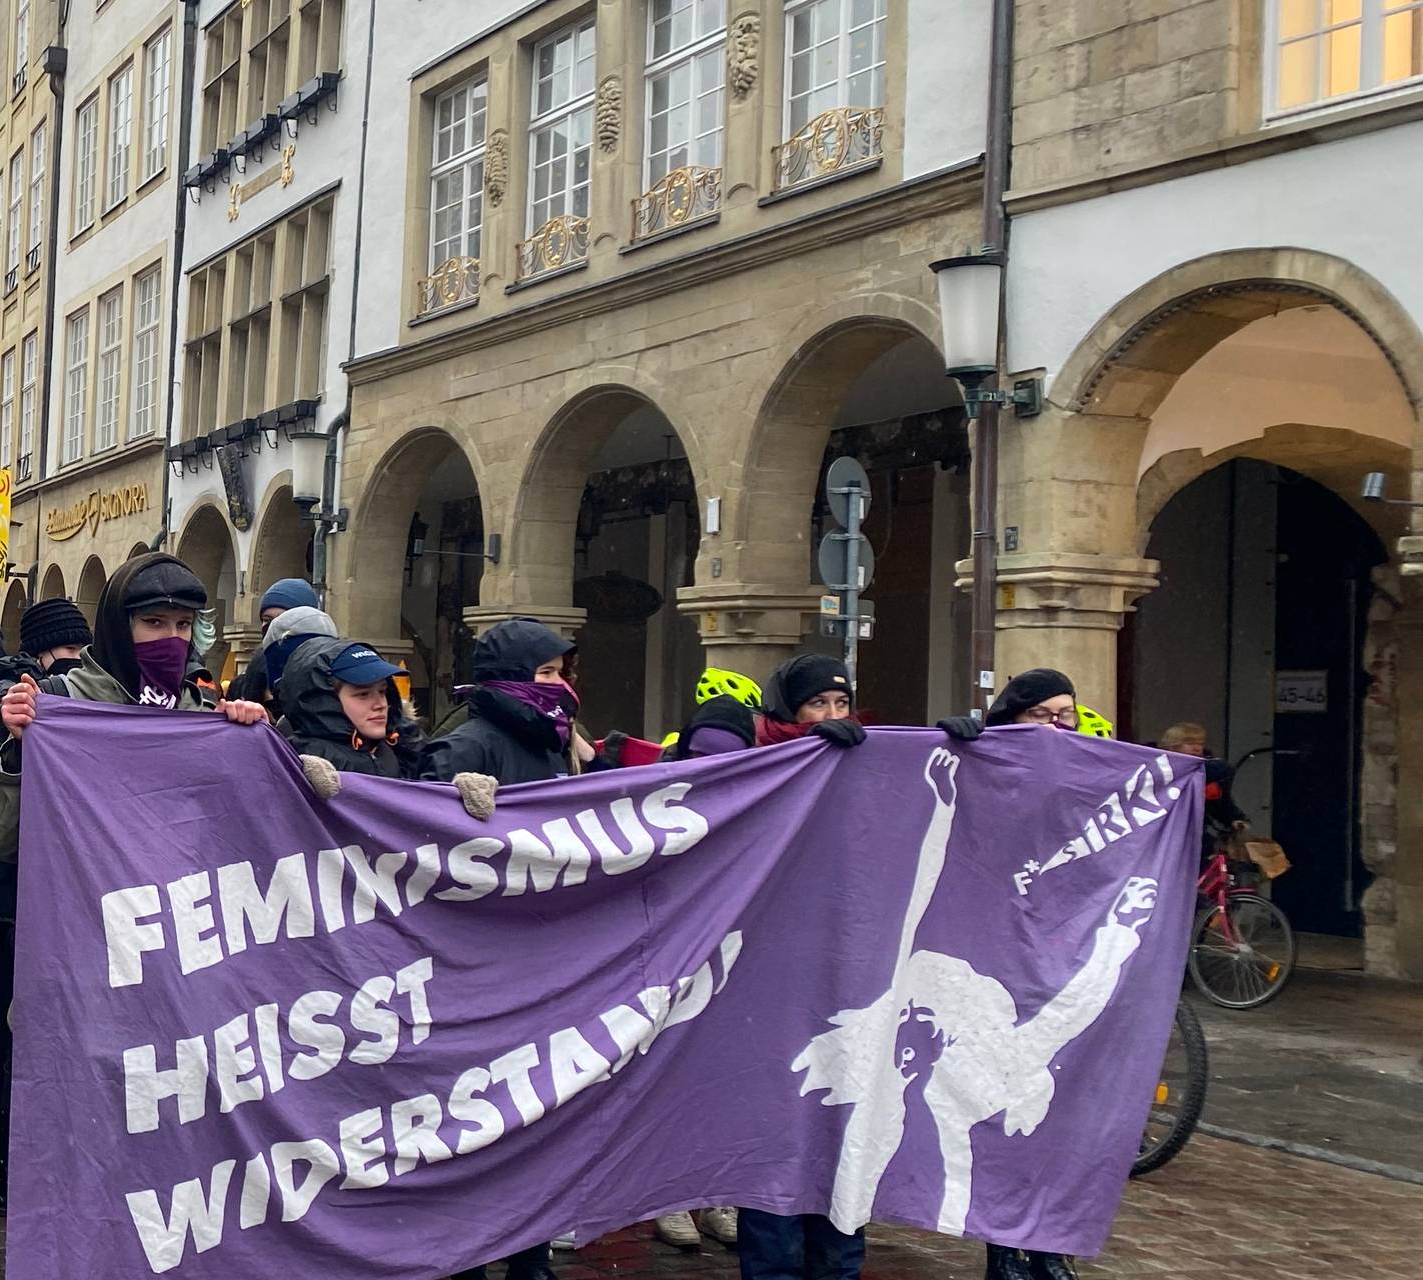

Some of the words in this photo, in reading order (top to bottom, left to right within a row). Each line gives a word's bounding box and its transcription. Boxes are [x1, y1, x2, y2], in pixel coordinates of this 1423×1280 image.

[102, 483, 150, 521] SIGNORA
[1278, 687, 1325, 704] 45-46
[101, 782, 710, 988] FEMINISMUS
[124, 956, 435, 1134] HEISST
[125, 929, 744, 1275] WIDERSTAND!
